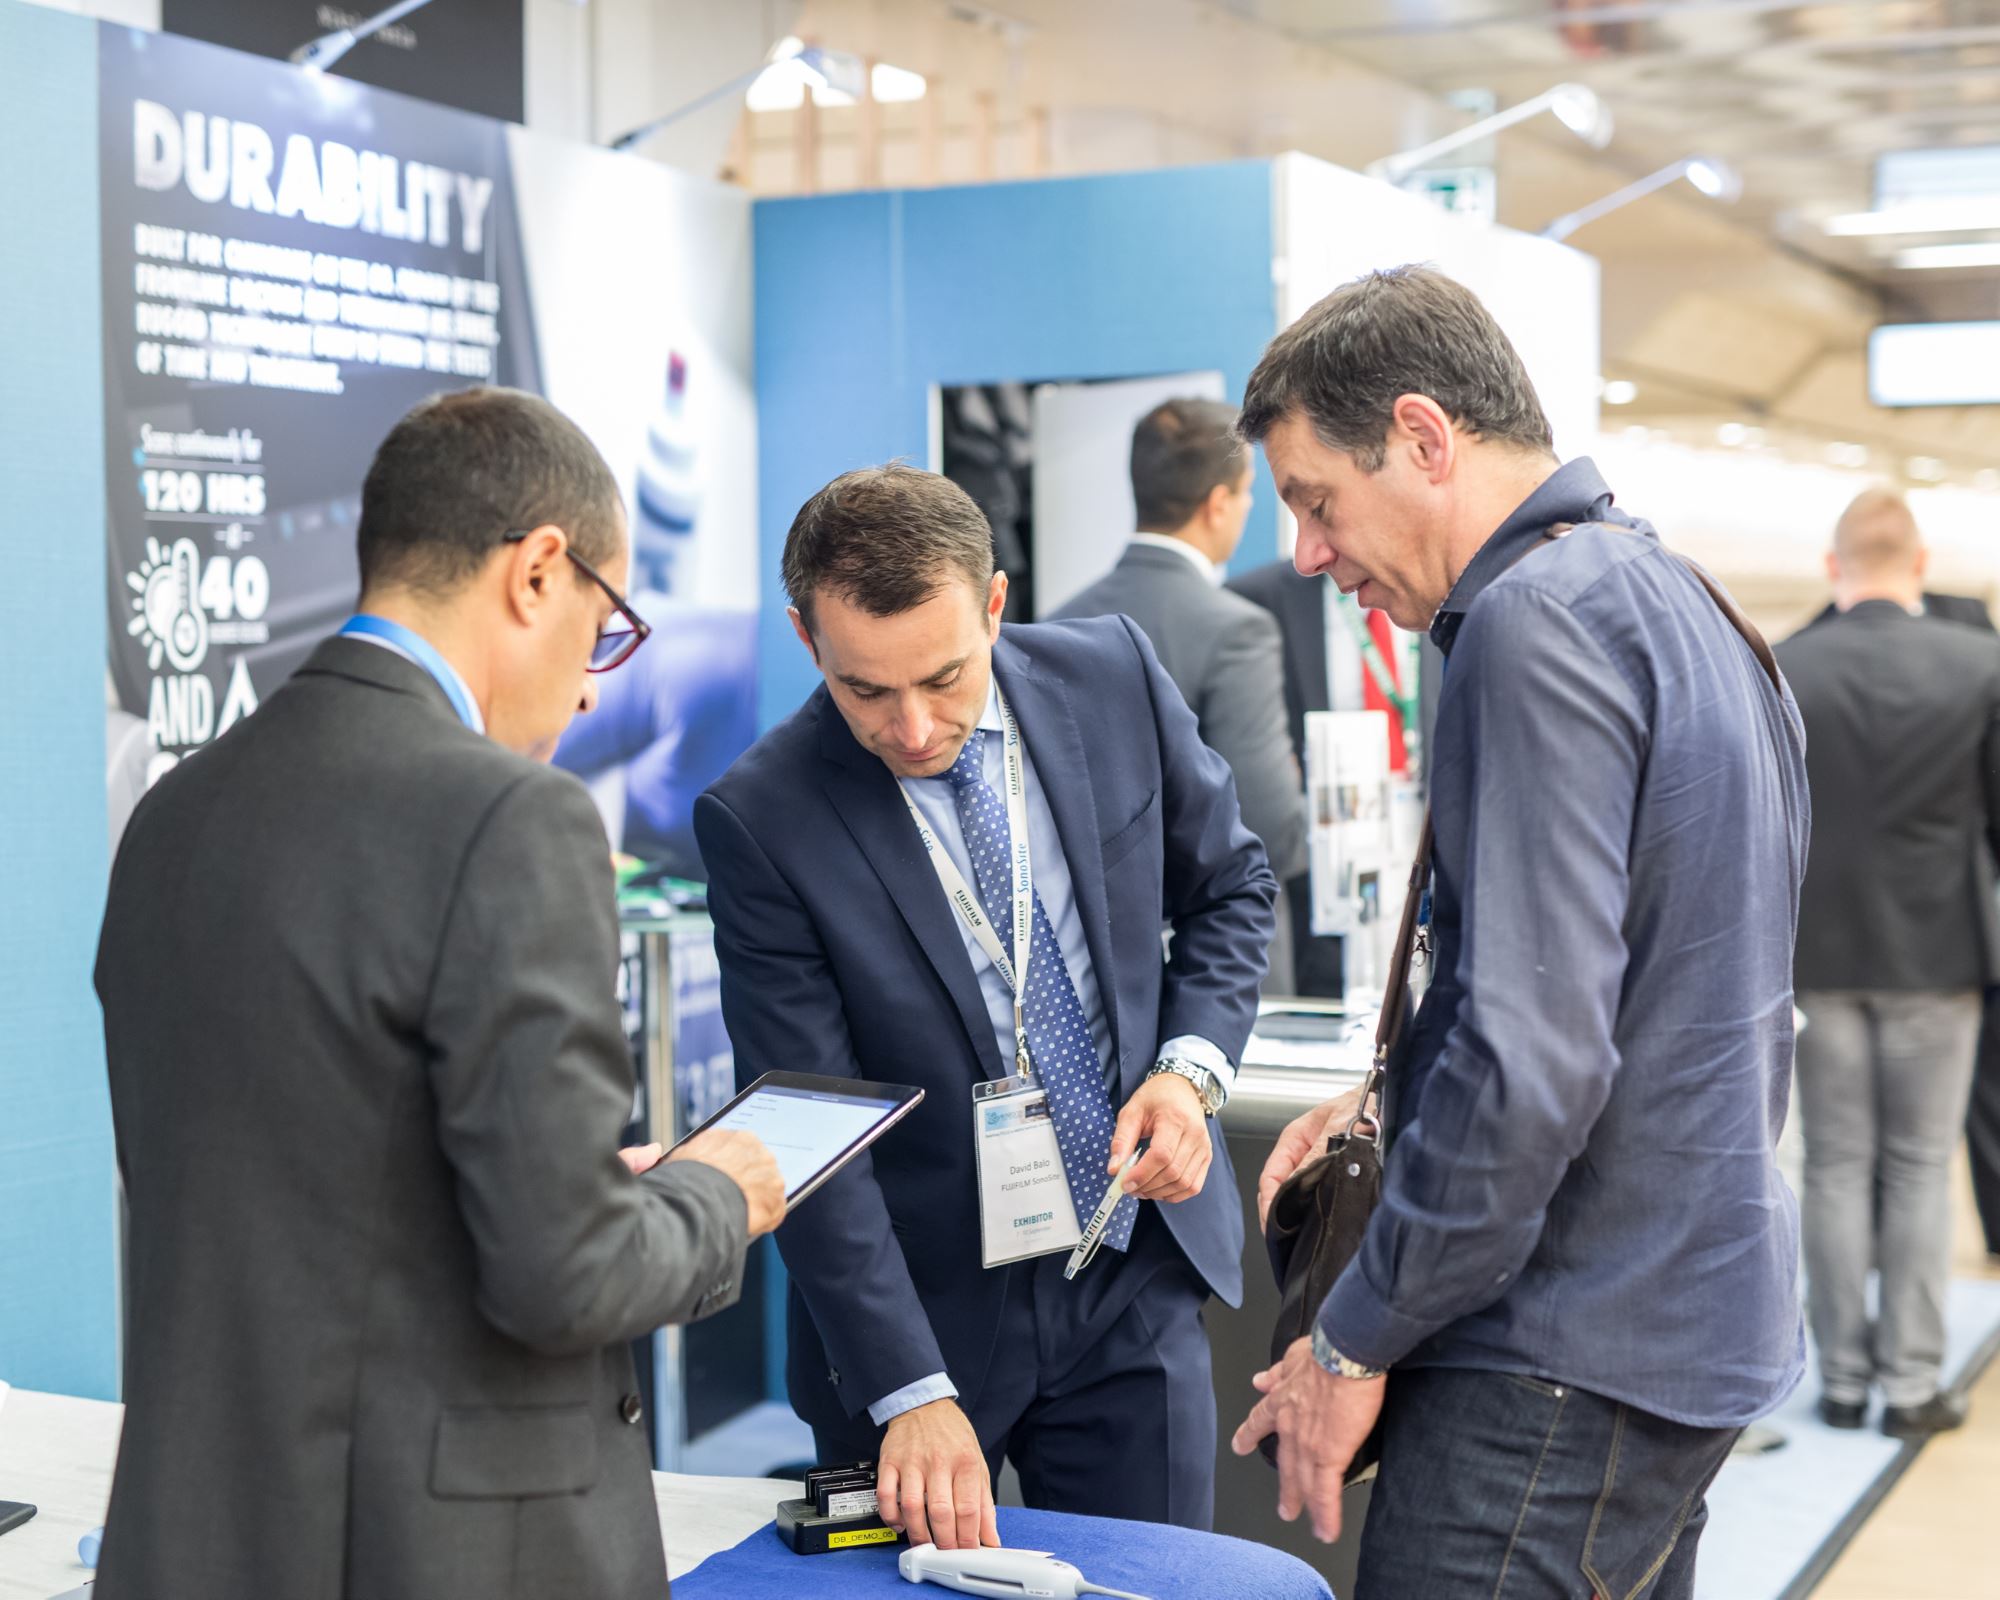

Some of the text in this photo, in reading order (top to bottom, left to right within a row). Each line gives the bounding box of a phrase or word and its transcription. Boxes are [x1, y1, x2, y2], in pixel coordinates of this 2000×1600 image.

[134, 98, 494, 253] DURABILITY
[143, 470, 266, 516] 120 HRS
[200, 556, 269, 620] 40
[149, 674, 214, 746] AND
[1017, 843, 1029, 893] SonoSite
[956, 889, 983, 927] FUJIFILM
[1009, 1163, 1032, 1175] David
[1013, 1211, 1053, 1228] EXHIBITOR
[1076, 1210, 1106, 1253] FUJIFILM
